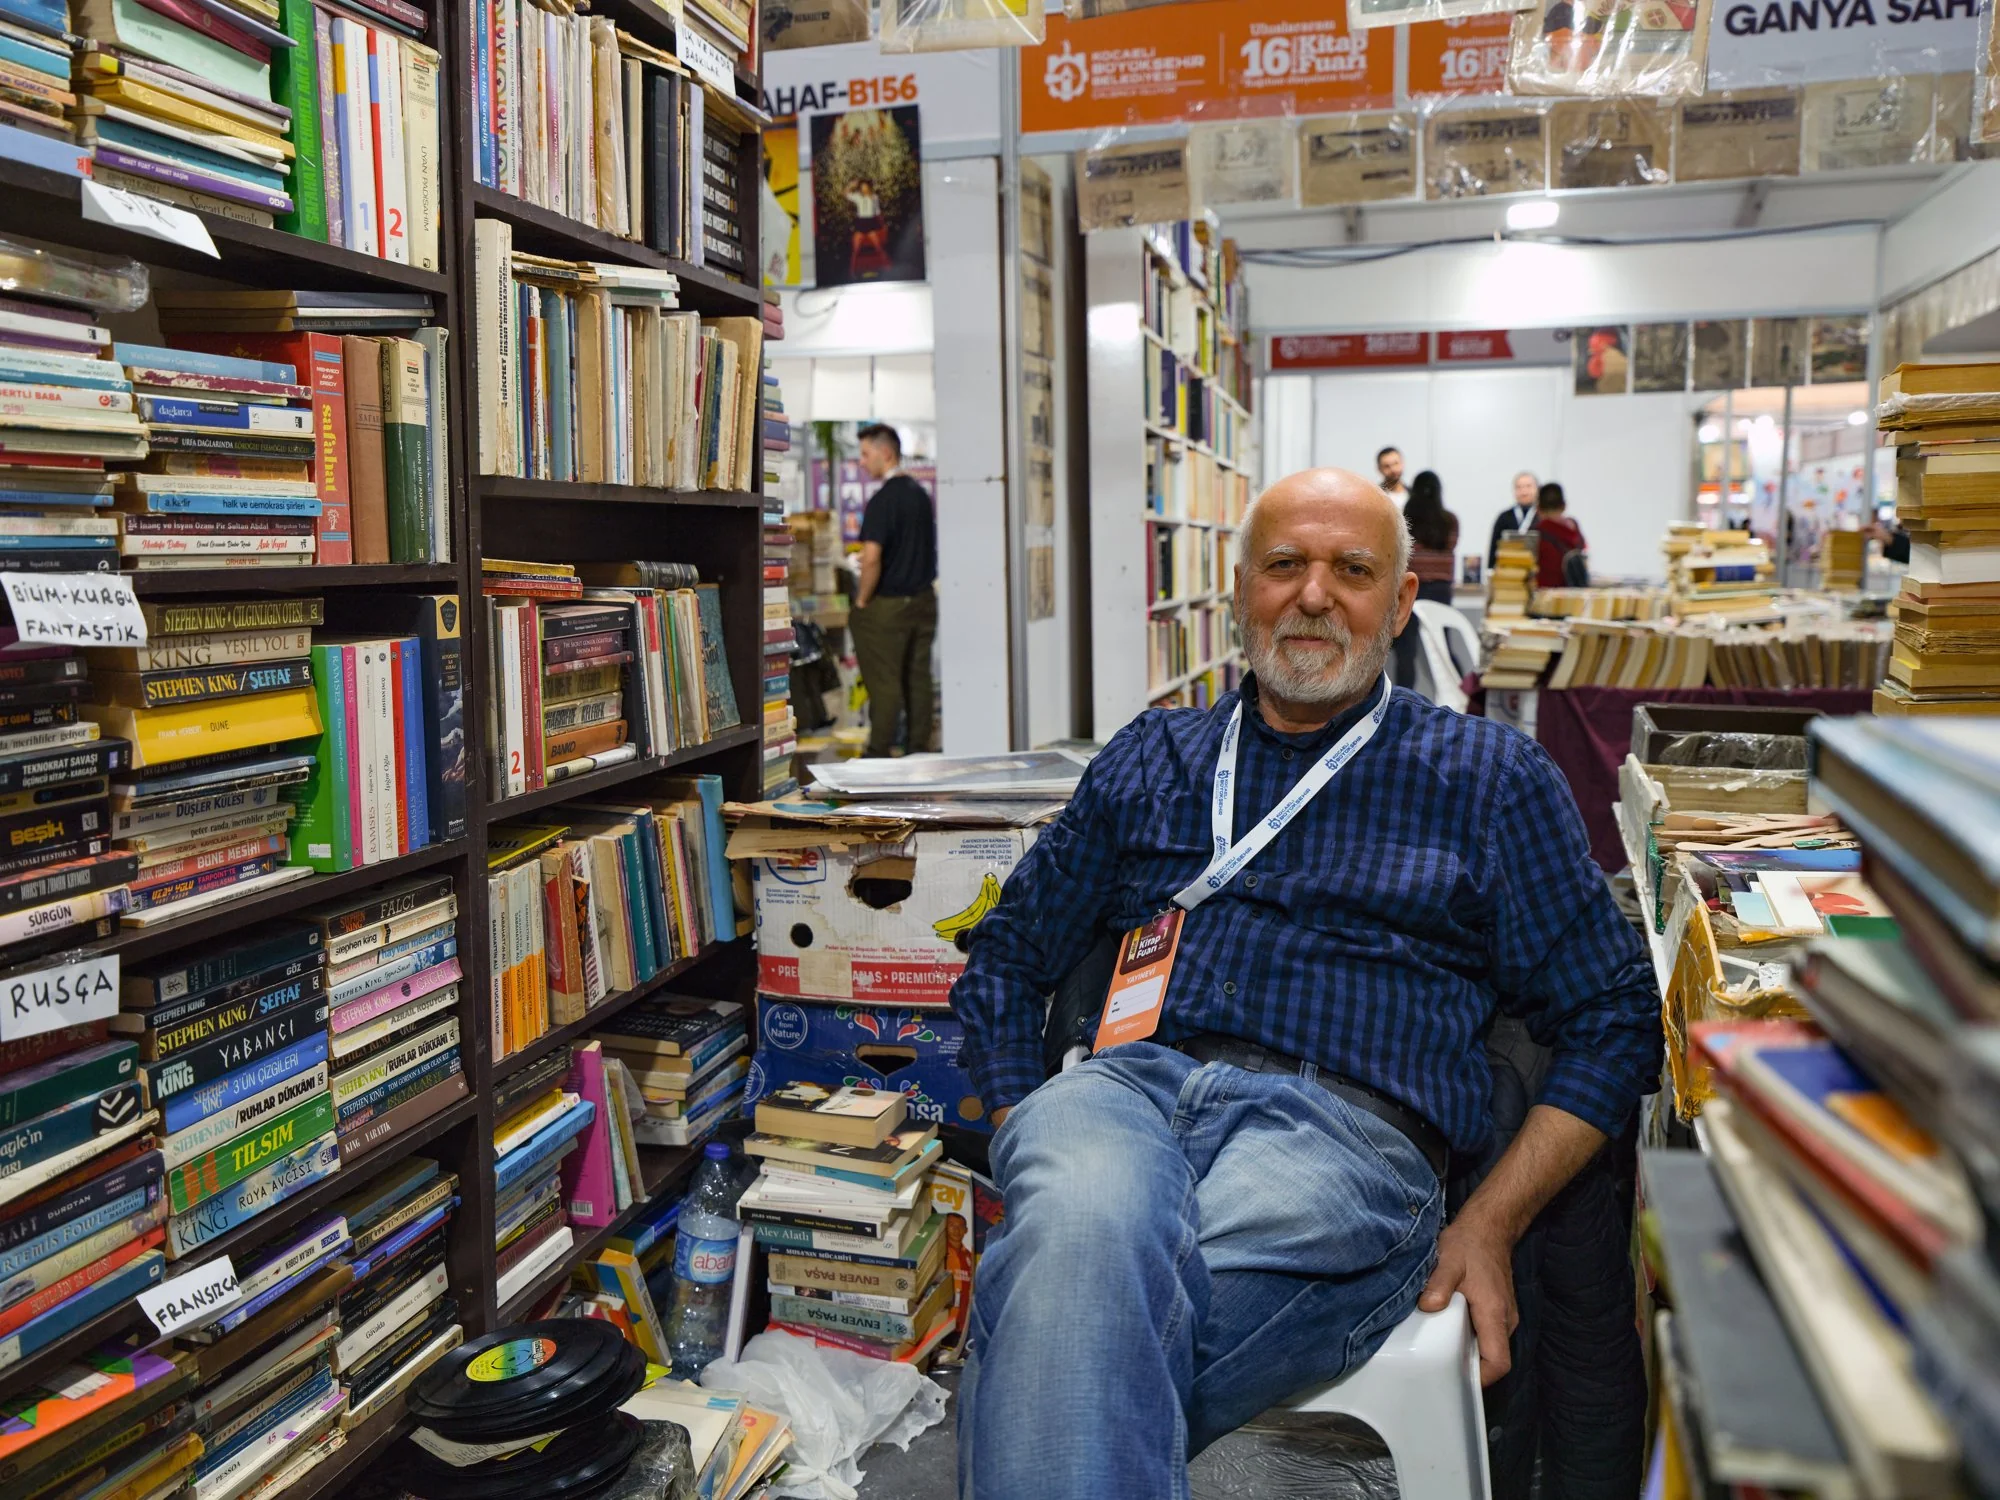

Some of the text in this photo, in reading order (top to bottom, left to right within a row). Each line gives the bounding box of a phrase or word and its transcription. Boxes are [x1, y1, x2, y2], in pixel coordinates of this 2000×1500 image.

[1725, 0, 1979, 36] GANYA SAH
[1300, 31, 1369, 54] Kitap
[1241, 37, 1290, 77] 16
[1440, 48, 1479, 79] 16
[359, 202, 369, 231] 1
[389, 207, 403, 237] 2
[222, 499, 239, 509] halk
[227, 521, 249, 530] Sultan
[250, 521, 269, 530] Abdal
[225, 558, 247, 566] ORHAN
[25, 618, 139, 643] FANTASTİK
[164, 607, 201, 632] STEPHEN
[204, 606, 226, 629] KING
[150, 647, 212, 670] KING
[223, 635, 289, 657] YEŞİL YOL
[146, 677, 205, 700] STEPHEN
[207, 672, 238, 692] KING
[209, 720, 230, 733] DUNE
[22, 757, 70, 775] TEKNOKRAT
[511, 750, 521, 775] 2
[190, 825, 209, 838] peter
[369, 806, 377, 855] RAMSES
[155, 859, 184, 877] HERBERT
[28, 905, 72, 927] SÜRGÜN
[380, 894, 416, 920] FALCI
[335, 933, 378, 957] stephen king
[333, 976, 382, 1002] STEPHEN KING
[891, 971, 948, 985] PREMIUM
[10, 968, 113, 1018] RUSÇA
[153, 998, 206, 1026] STEPHEN KING
[341, 1001, 374, 1025] STEPHEN
[374, 994, 392, 1011] KING
[783, 1011, 799, 1023] Gift
[157, 1016, 216, 1055] STEPHEN
[218, 1004, 247, 1030] KING
[771, 1027, 801, 1039] Nature
[219, 1018, 294, 1068] YABANCI
[162, 1060, 188, 1077] STEPHEN
[156, 1066, 195, 1099] KING
[231, 1119, 295, 1173] TILSIM
[345, 1136, 361, 1154] KING
[271, 1160, 313, 1192] AVCISI
[47, 1195, 92, 1220] DUROTAN
[177, 1207, 229, 1251] KING
[756, 1226, 781, 1239] Alev
[804, 1267, 880, 1286] ENVER PAŞA
[155, 1274, 240, 1328] FRANSIZCA
[807, 1308, 881, 1330] ENVER PAŞA
[214, 1460, 241, 1484] PESSOA
